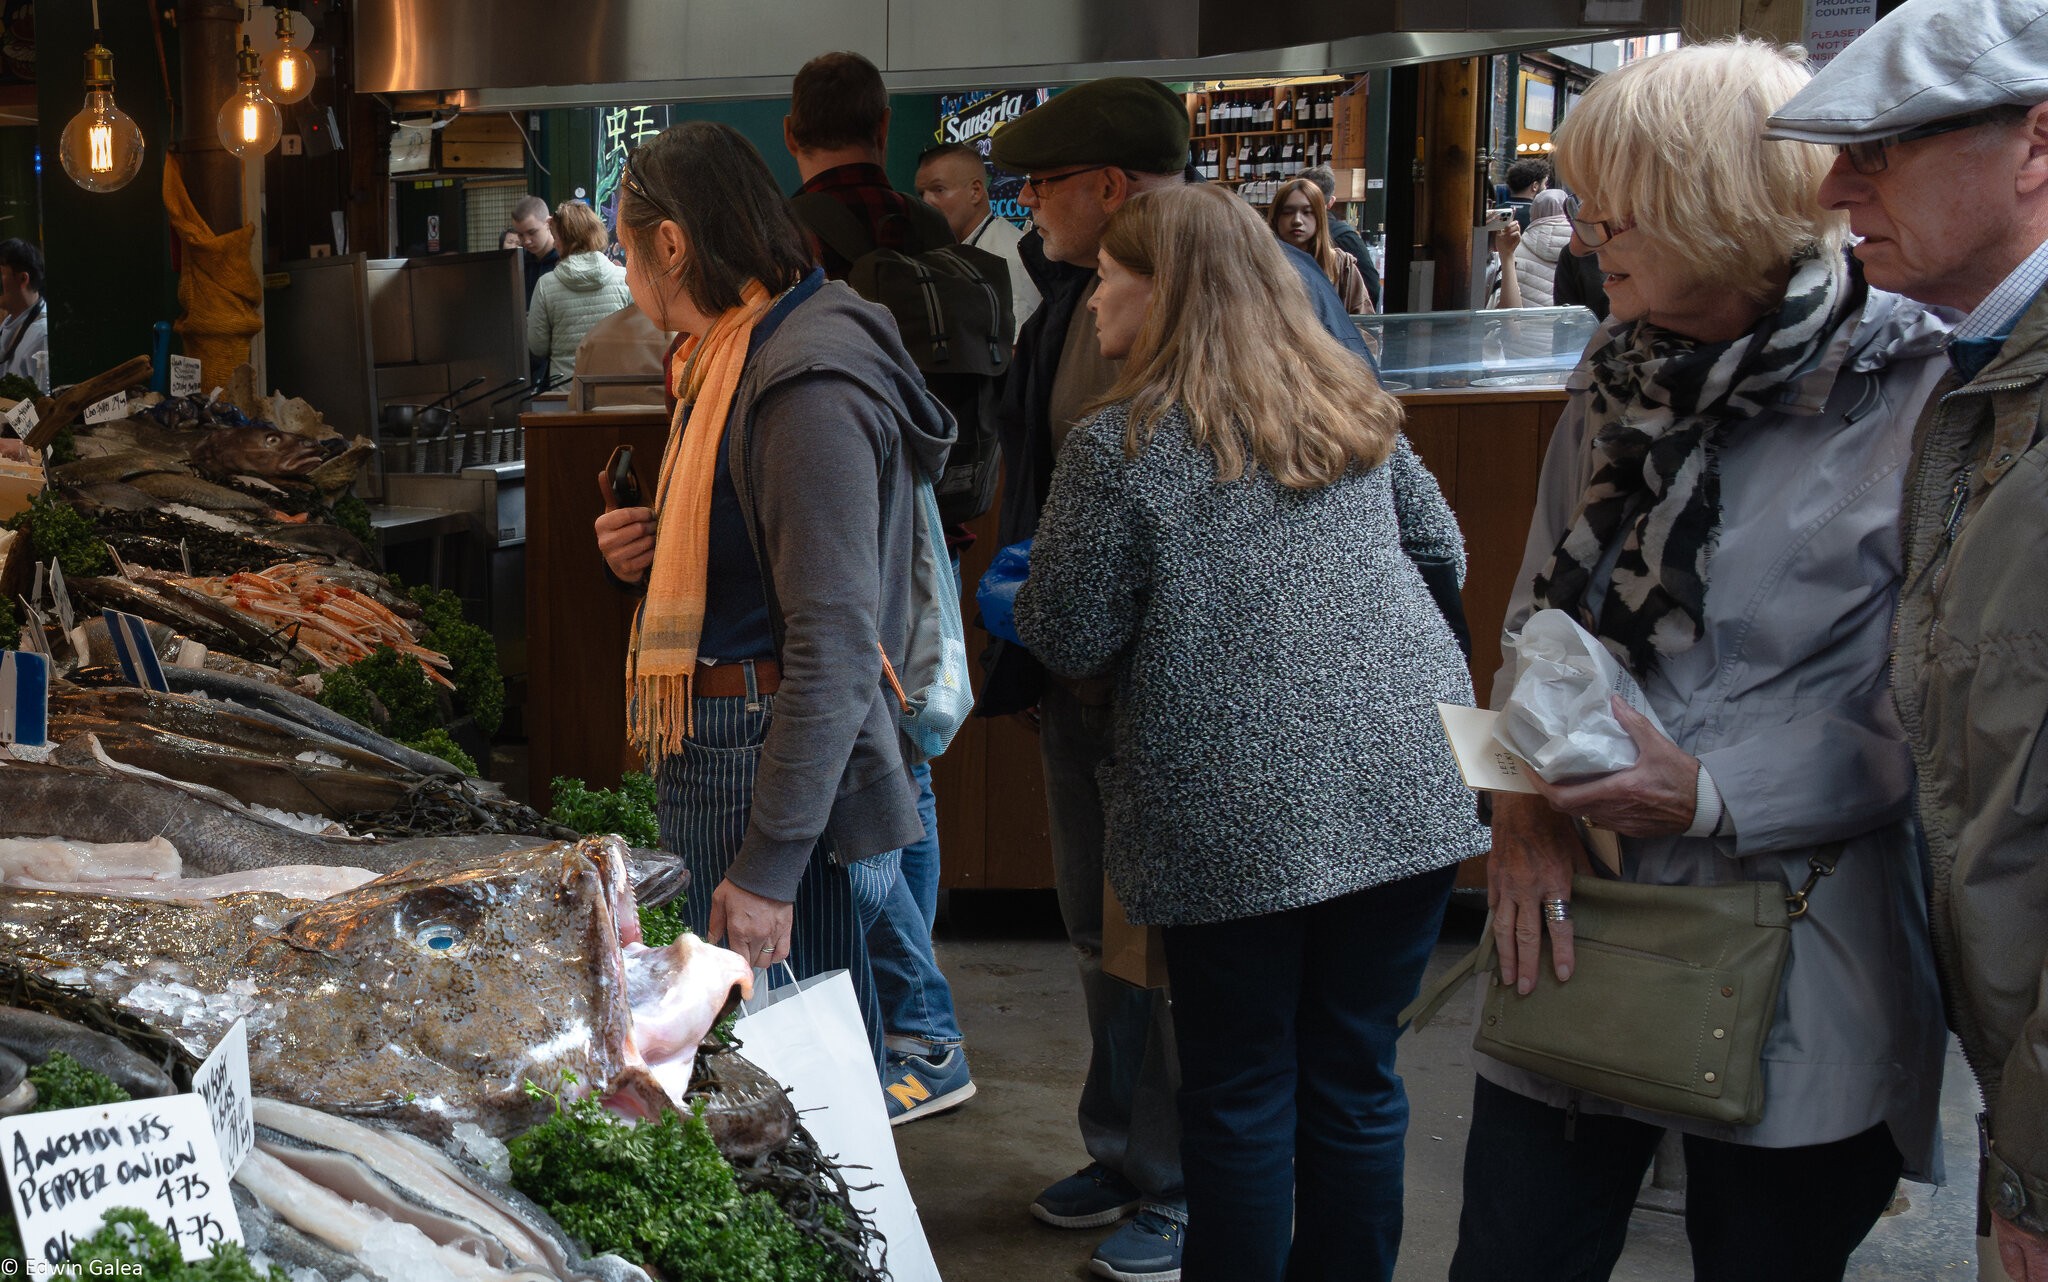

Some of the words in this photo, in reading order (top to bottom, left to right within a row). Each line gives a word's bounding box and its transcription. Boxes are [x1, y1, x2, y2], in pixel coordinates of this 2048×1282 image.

[1815, 6, 1871, 17] COUNTER
[1811, 29, 1855, 39] PLEASE
[1816, 41, 1840, 50] NOT
[945, 94, 1022, 143] Sangria
[886, 1073, 931, 1110] N
[18, 1163, 111, 1219] PEPPER
